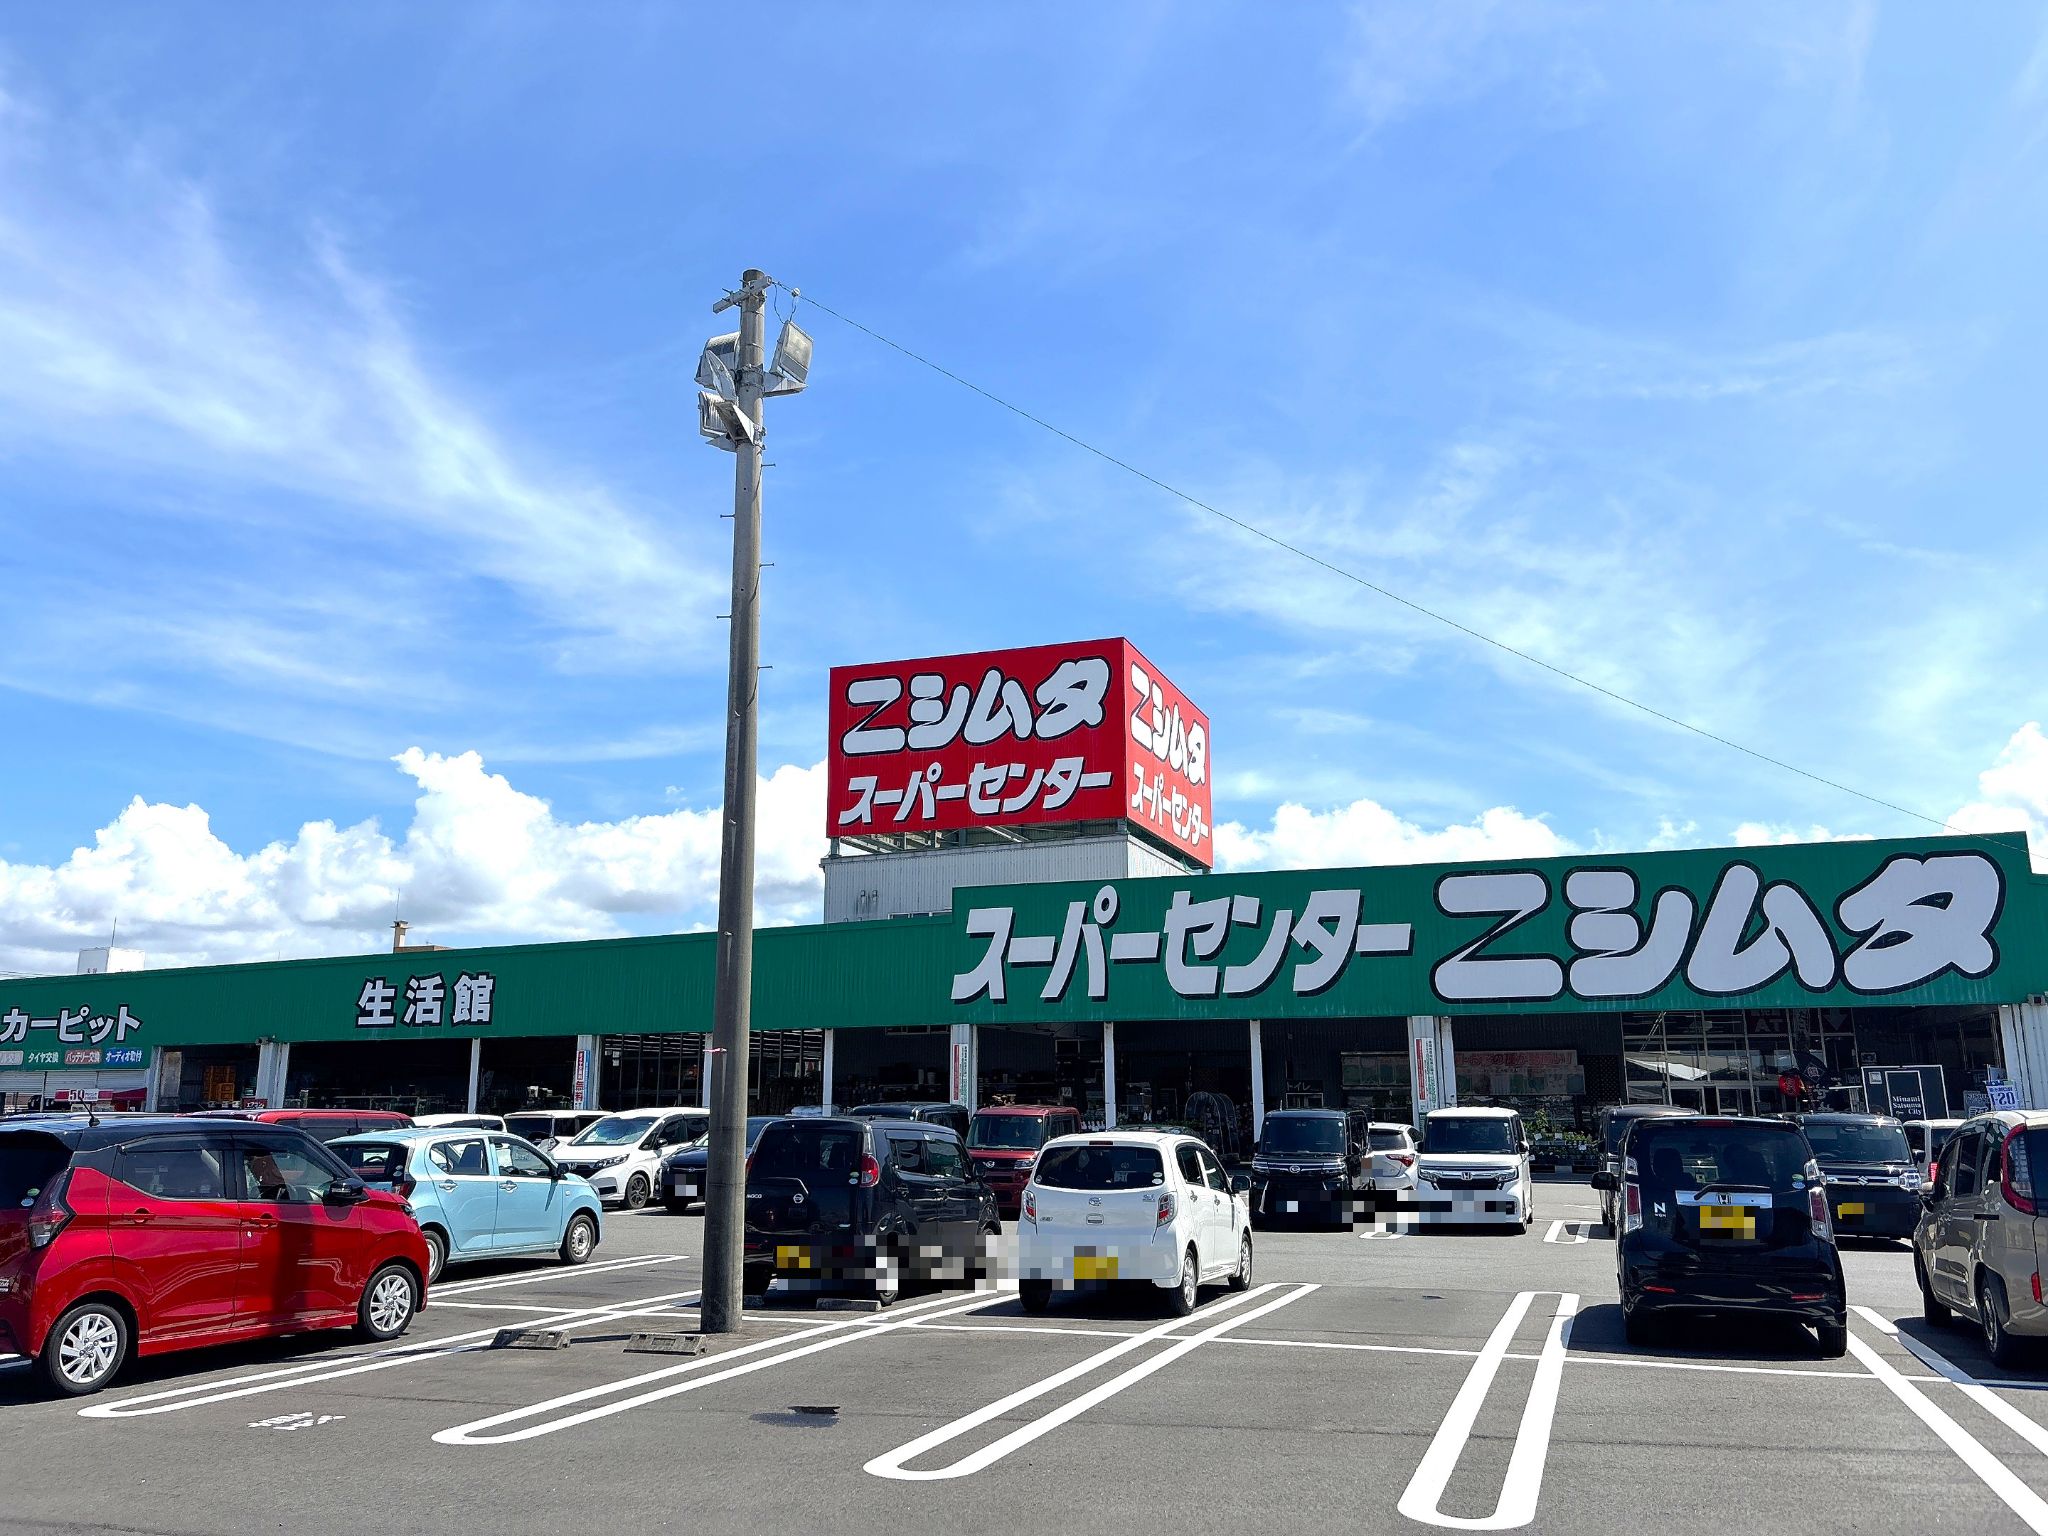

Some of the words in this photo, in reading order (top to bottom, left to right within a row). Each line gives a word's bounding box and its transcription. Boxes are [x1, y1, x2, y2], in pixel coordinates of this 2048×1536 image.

[842, 656, 1112, 757] ニシムタ
[1130, 661, 1206, 787] ニシムタ
[838, 757, 1112, 826] スーパーセンター
[1131, 762, 1209, 846] スーパーセンター
[950, 885, 1415, 1004] スーパーセンター
[1430, 850, 2005, 1003] ニシムタ
[0, 1004, 145, 1044] カーピット
[355, 972, 496, 1029] 生活館
[28, 1051, 59, 1063] タイヤ交換
[105, 1049, 143, 1063] オーディオ取付
[1286, 1081, 1311, 1092] トイレ
[1893, 1102, 1922, 1110] Satsuma
[1654, 1201, 1666, 1213] N
